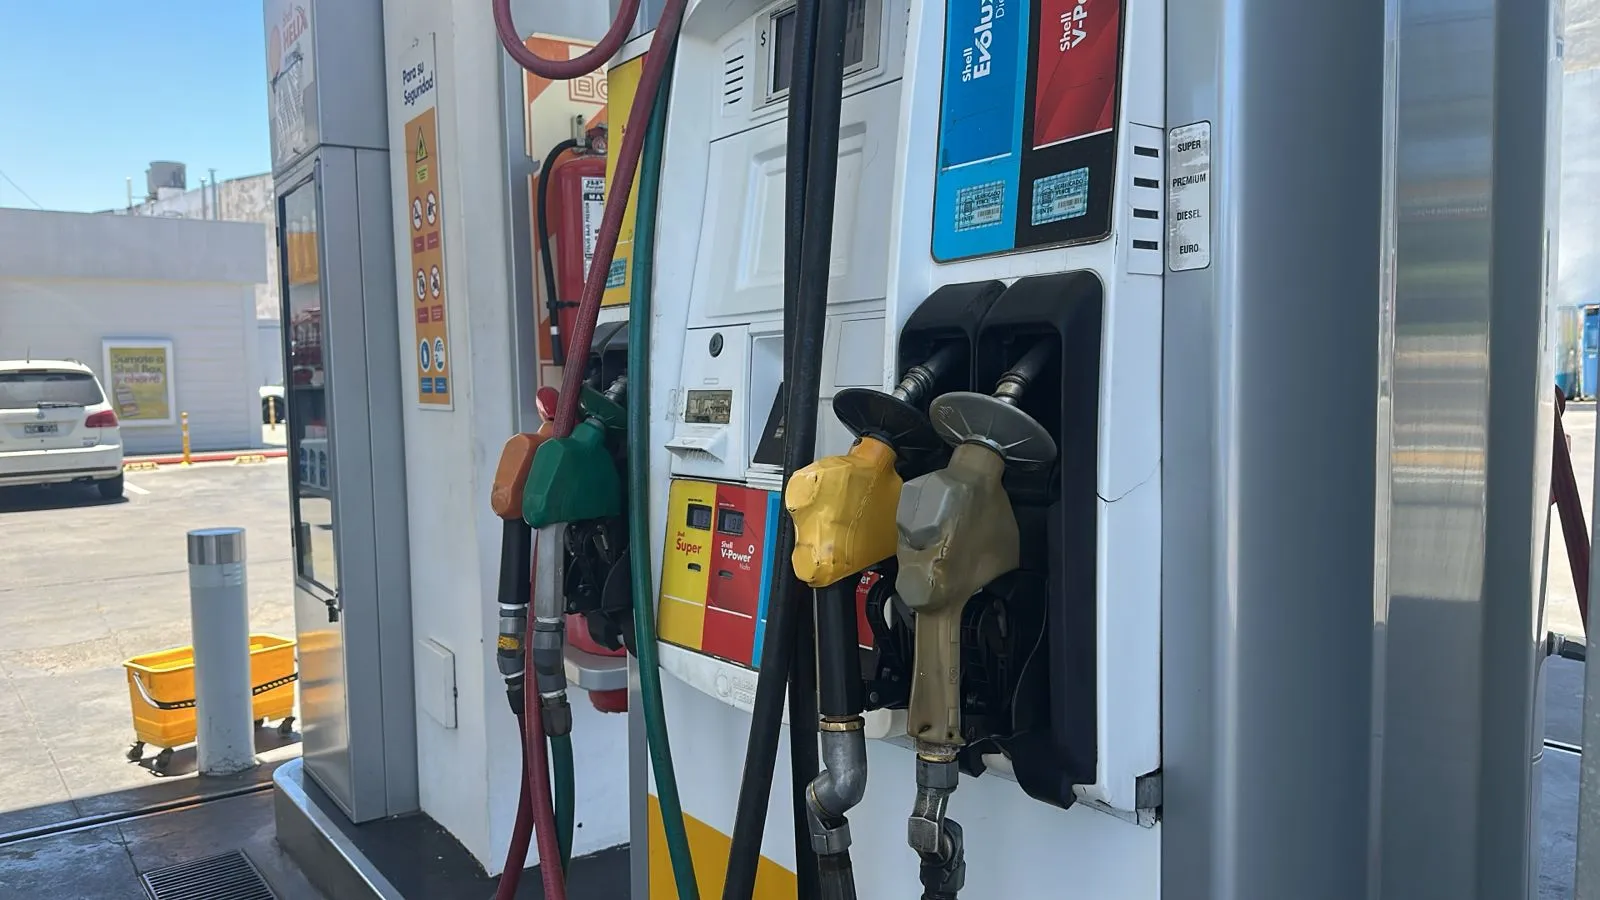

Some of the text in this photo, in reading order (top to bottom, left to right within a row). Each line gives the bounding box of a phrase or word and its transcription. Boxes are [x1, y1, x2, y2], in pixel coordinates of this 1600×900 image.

[760, 29, 766, 47] $
[1060, 11, 1072, 52] Shell
[961, 47, 973, 82] Shell
[402, 61, 425, 86] Para su
[404, 70, 433, 106] Seguridad
[1177, 139, 1202, 153] SUPER
[1172, 173, 1206, 188] PREMIUM
[1176, 209, 1202, 221] DIESEL
[1179, 243, 1199, 255] EURO
[676, 538, 702, 556] Super
[721, 540, 734, 549] Shell
[721, 548, 751, 562] V-Power
